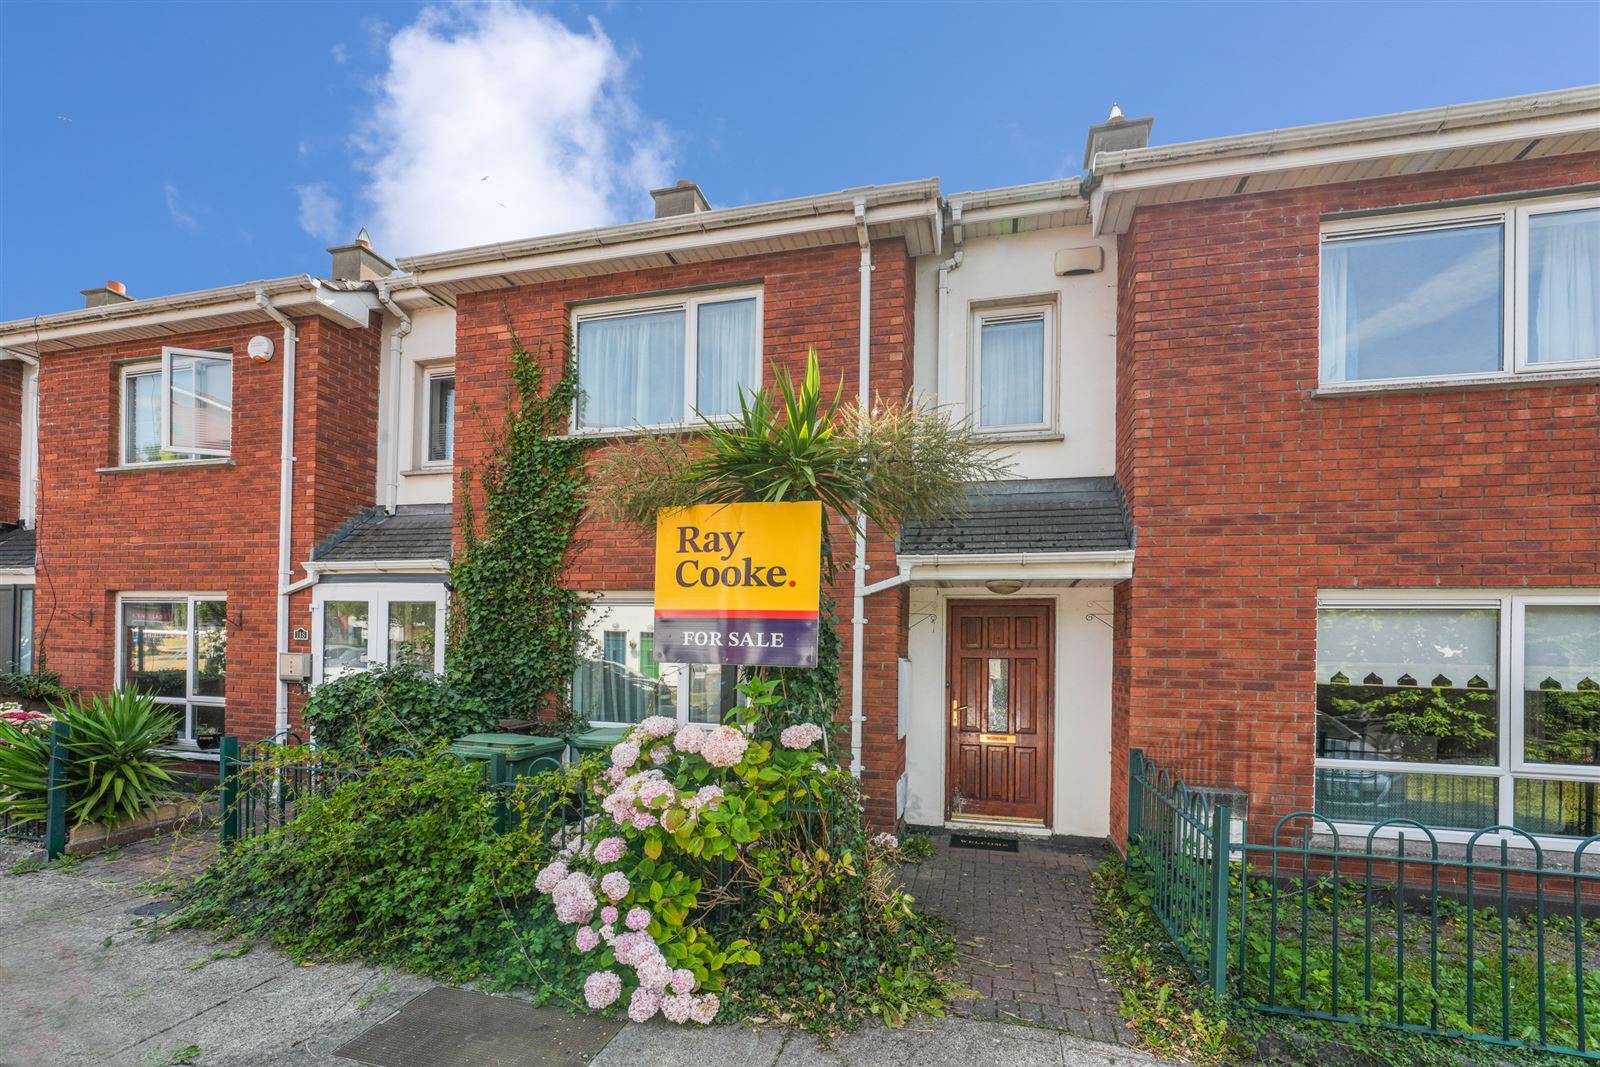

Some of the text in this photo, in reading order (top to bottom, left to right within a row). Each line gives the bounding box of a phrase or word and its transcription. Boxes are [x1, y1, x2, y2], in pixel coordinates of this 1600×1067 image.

[675, 526, 745, 561] Ray
[675, 556, 797, 588] Cooke.
[682, 631, 784, 648] FOR SALE
